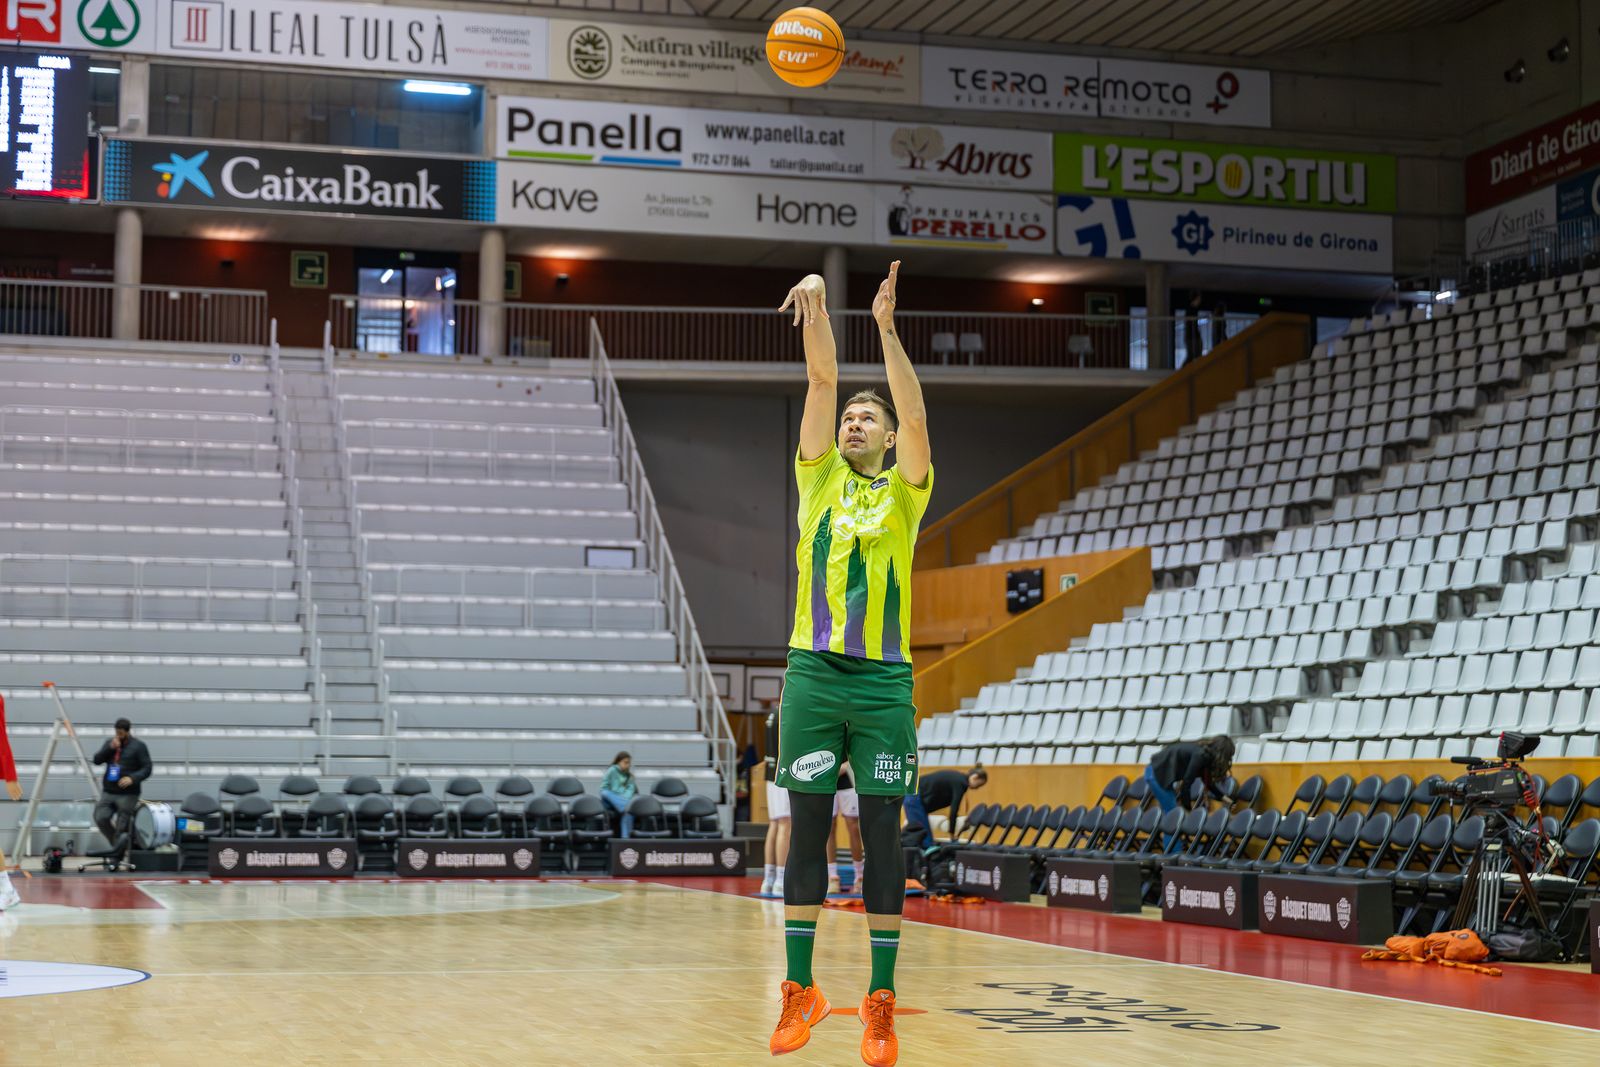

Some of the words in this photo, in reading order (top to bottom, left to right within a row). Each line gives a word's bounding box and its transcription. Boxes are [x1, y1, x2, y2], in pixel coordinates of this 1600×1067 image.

[230, 9, 326, 57] LLEAL
[340, 14, 448, 66] TULSÀ
[774, 20, 823, 42] Wilson
[621, 55, 668, 69] Camping
[678, 60, 736, 72] Bungalows
[507, 107, 683, 153] Panella
[704, 123, 846, 147] www.panella.cat
[936, 142, 1033, 179] Abras
[1490, 141, 1534, 186] Diari
[1536, 133, 1560, 166] de
[220, 155, 444, 211] CaixaBank
[1081, 143, 1368, 205] L'ESPORTIU
[513, 179, 599, 213] Kave
[756, 193, 858, 228] Home
[1222, 226, 1287, 247] Pirineu
[1293, 231, 1314, 249] de
[1319, 233, 1379, 253] Girona
[794, 753, 834, 776] famadesa
[875, 751, 895, 760] sabor
[874, 766, 902, 784] laga
[286, 852, 320, 867] GIRONA
[474, 853, 507, 867] GIRONA
[683, 852, 715, 866] GIRONA
[1308, 902, 1331, 922] GIRONA
[975, 982, 1282, 1032] endesa
[943, 1008, 1134, 1034] liga
